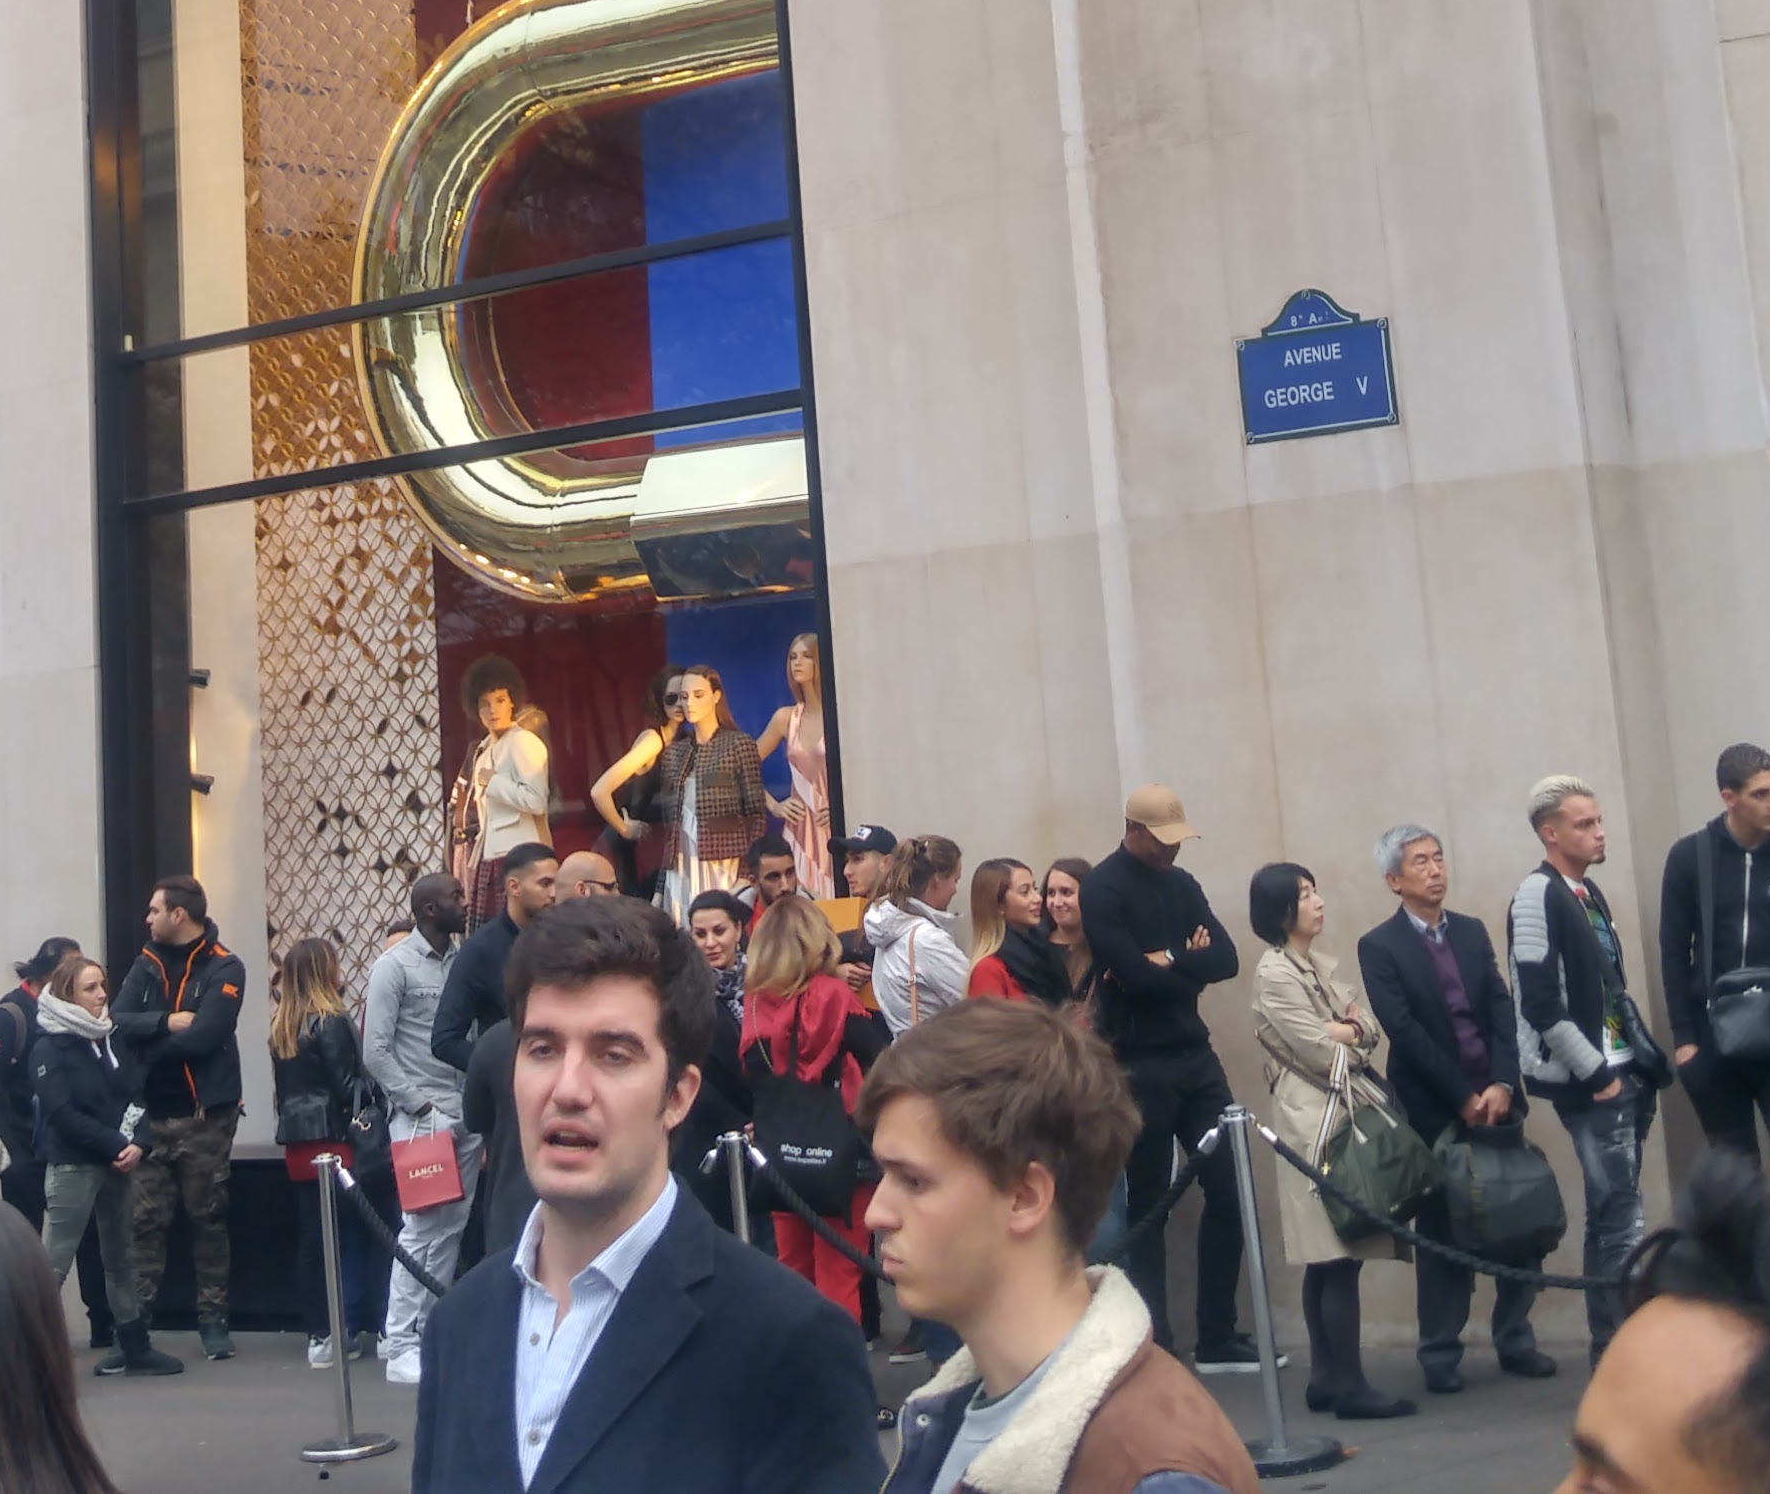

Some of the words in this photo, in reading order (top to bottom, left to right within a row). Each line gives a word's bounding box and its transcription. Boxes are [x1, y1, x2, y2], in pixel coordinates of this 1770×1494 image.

[1284, 343, 1342, 366] AVENUE
[1264, 382, 1334, 408] GEORGE
[1356, 376, 1368, 395] V
[780, 1143, 802, 1156] shop
[409, 1163, 444, 1179] LANCEL
